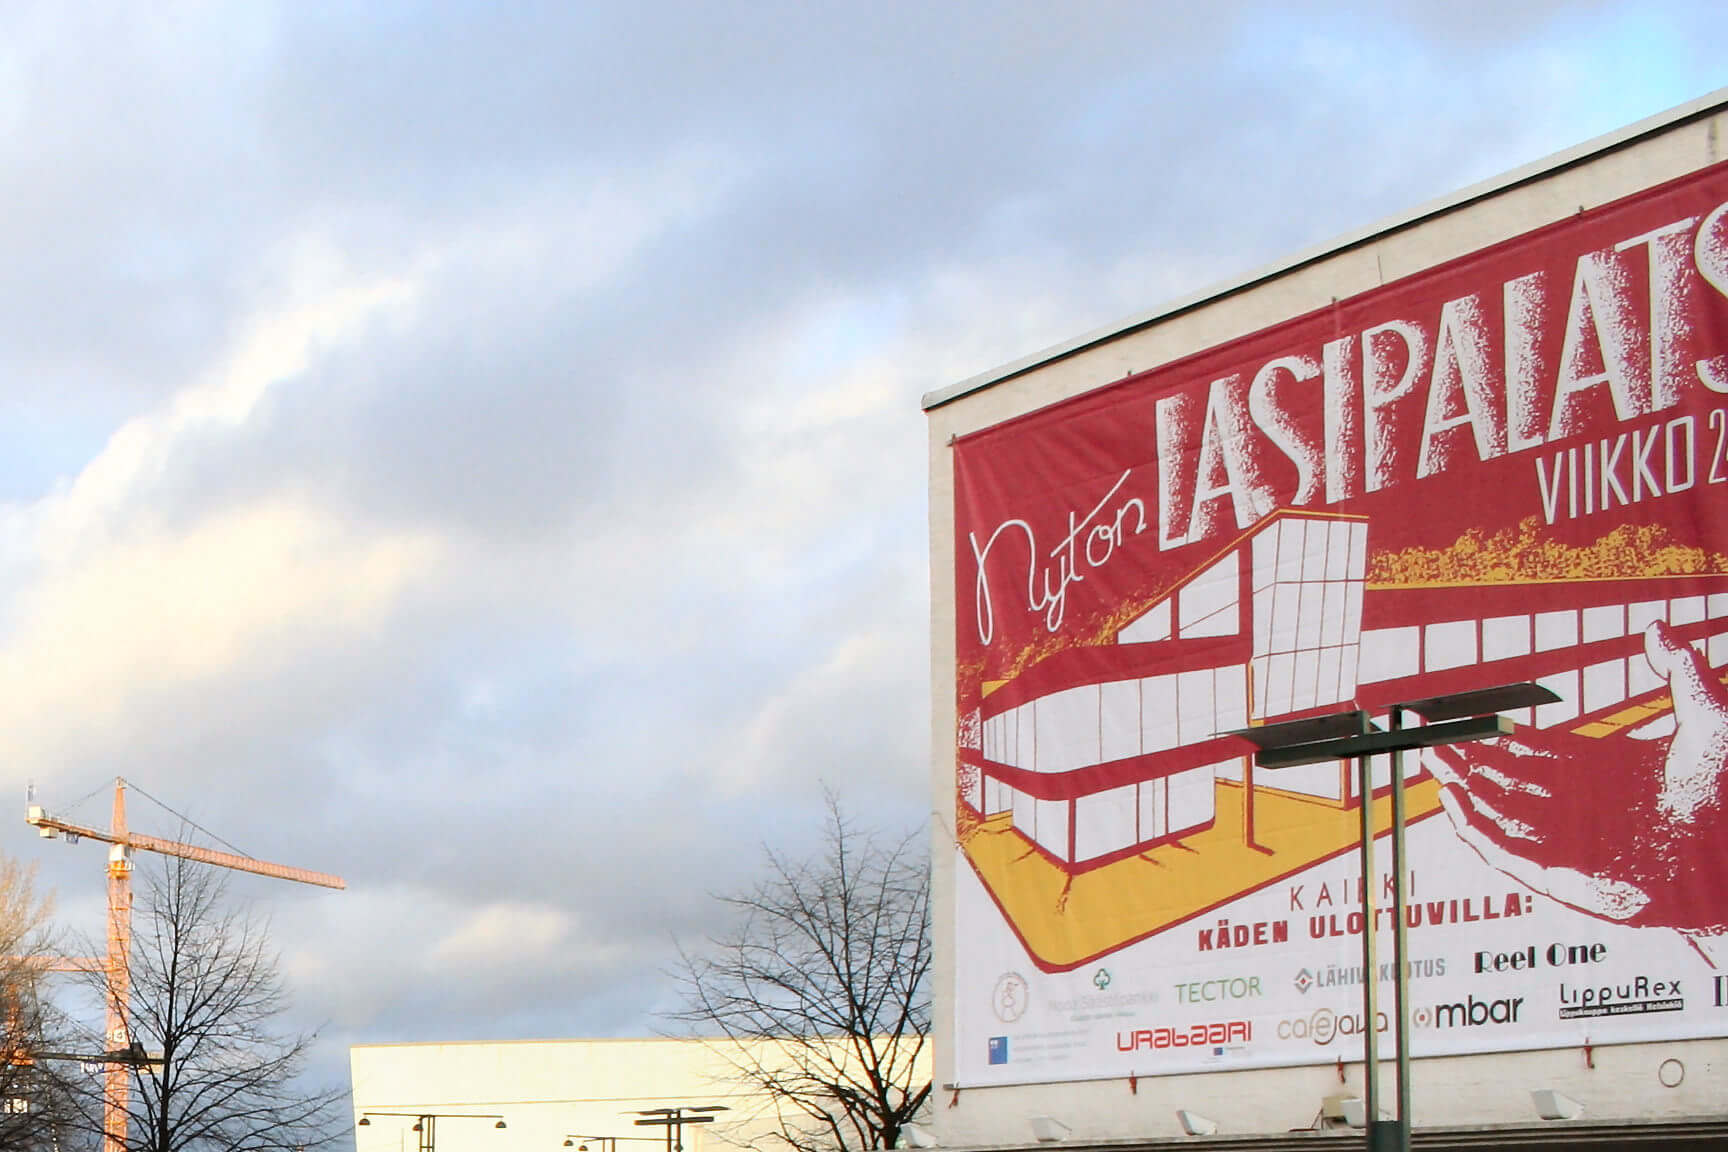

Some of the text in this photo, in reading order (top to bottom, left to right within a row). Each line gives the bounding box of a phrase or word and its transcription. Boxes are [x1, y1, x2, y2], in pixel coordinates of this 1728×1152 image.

[1535, 408, 1728, 526] VIIKKO 2
[1198, 918, 1288, 951] KÄDEN
[1316, 957, 1446, 988] LÄHIVKTUS
[1474, 942, 1607, 974] Reel One
[1174, 976, 1262, 1004] TECTOR
[1435, 995, 1525, 1029] mbar
